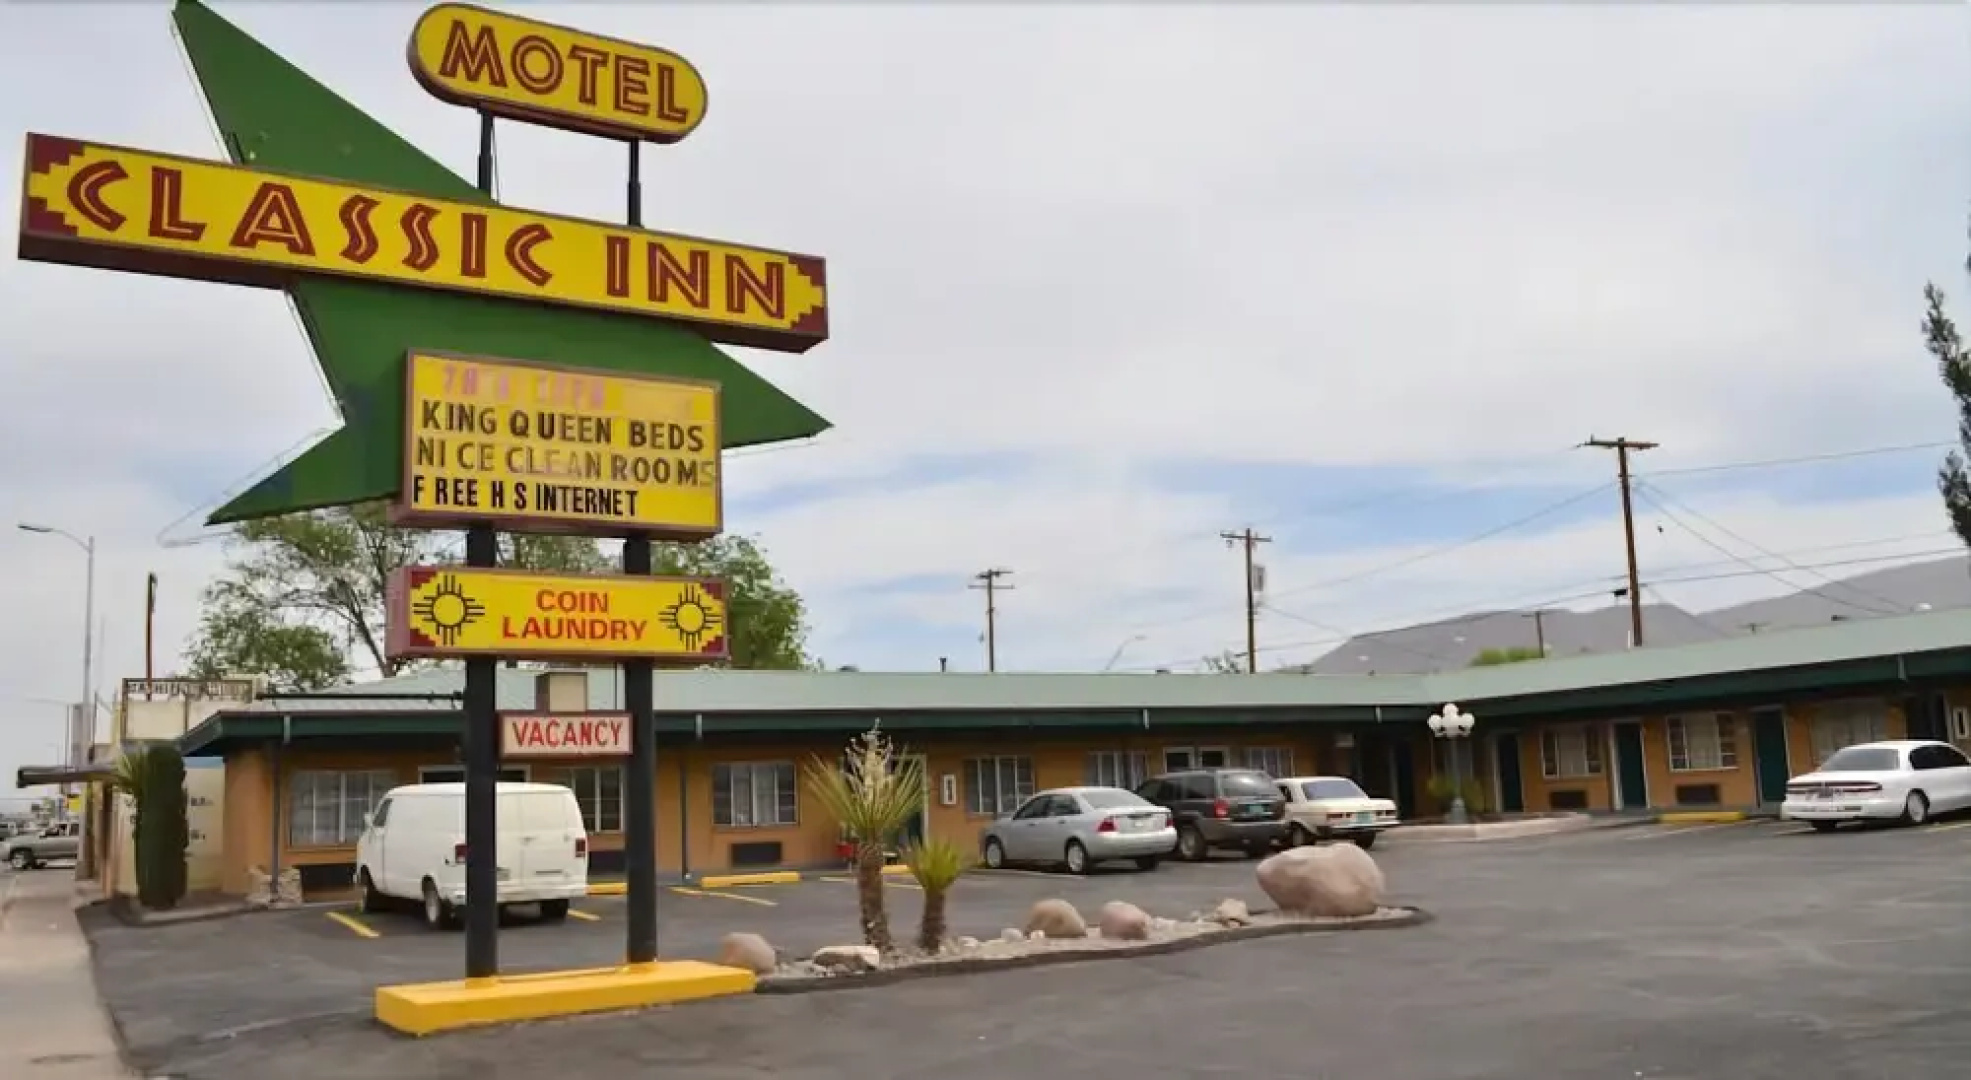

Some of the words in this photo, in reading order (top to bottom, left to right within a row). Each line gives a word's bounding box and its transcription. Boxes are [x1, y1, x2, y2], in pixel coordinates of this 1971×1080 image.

[439, 19, 689, 124] MOTEL
[67, 160, 553, 286] CLASSIC
[606, 236, 786, 319] INN
[422, 400, 498, 434] KING
[509, 411, 612, 444] QUEEN
[629, 422, 704, 451] BEDS
[417, 438, 495, 473] NICE
[505, 448, 602, 480] CLEAN
[611, 454, 715, 487] ROOMS
[413, 476, 478, 507] FREE
[491, 480, 504, 509] H
[514, 482, 528, 511] S
[535, 483, 638, 516] INTERNET
[536, 589, 609, 614] COIN
[502, 616, 648, 640] LAUNDRY
[512, 719, 622, 748] VACANCY
